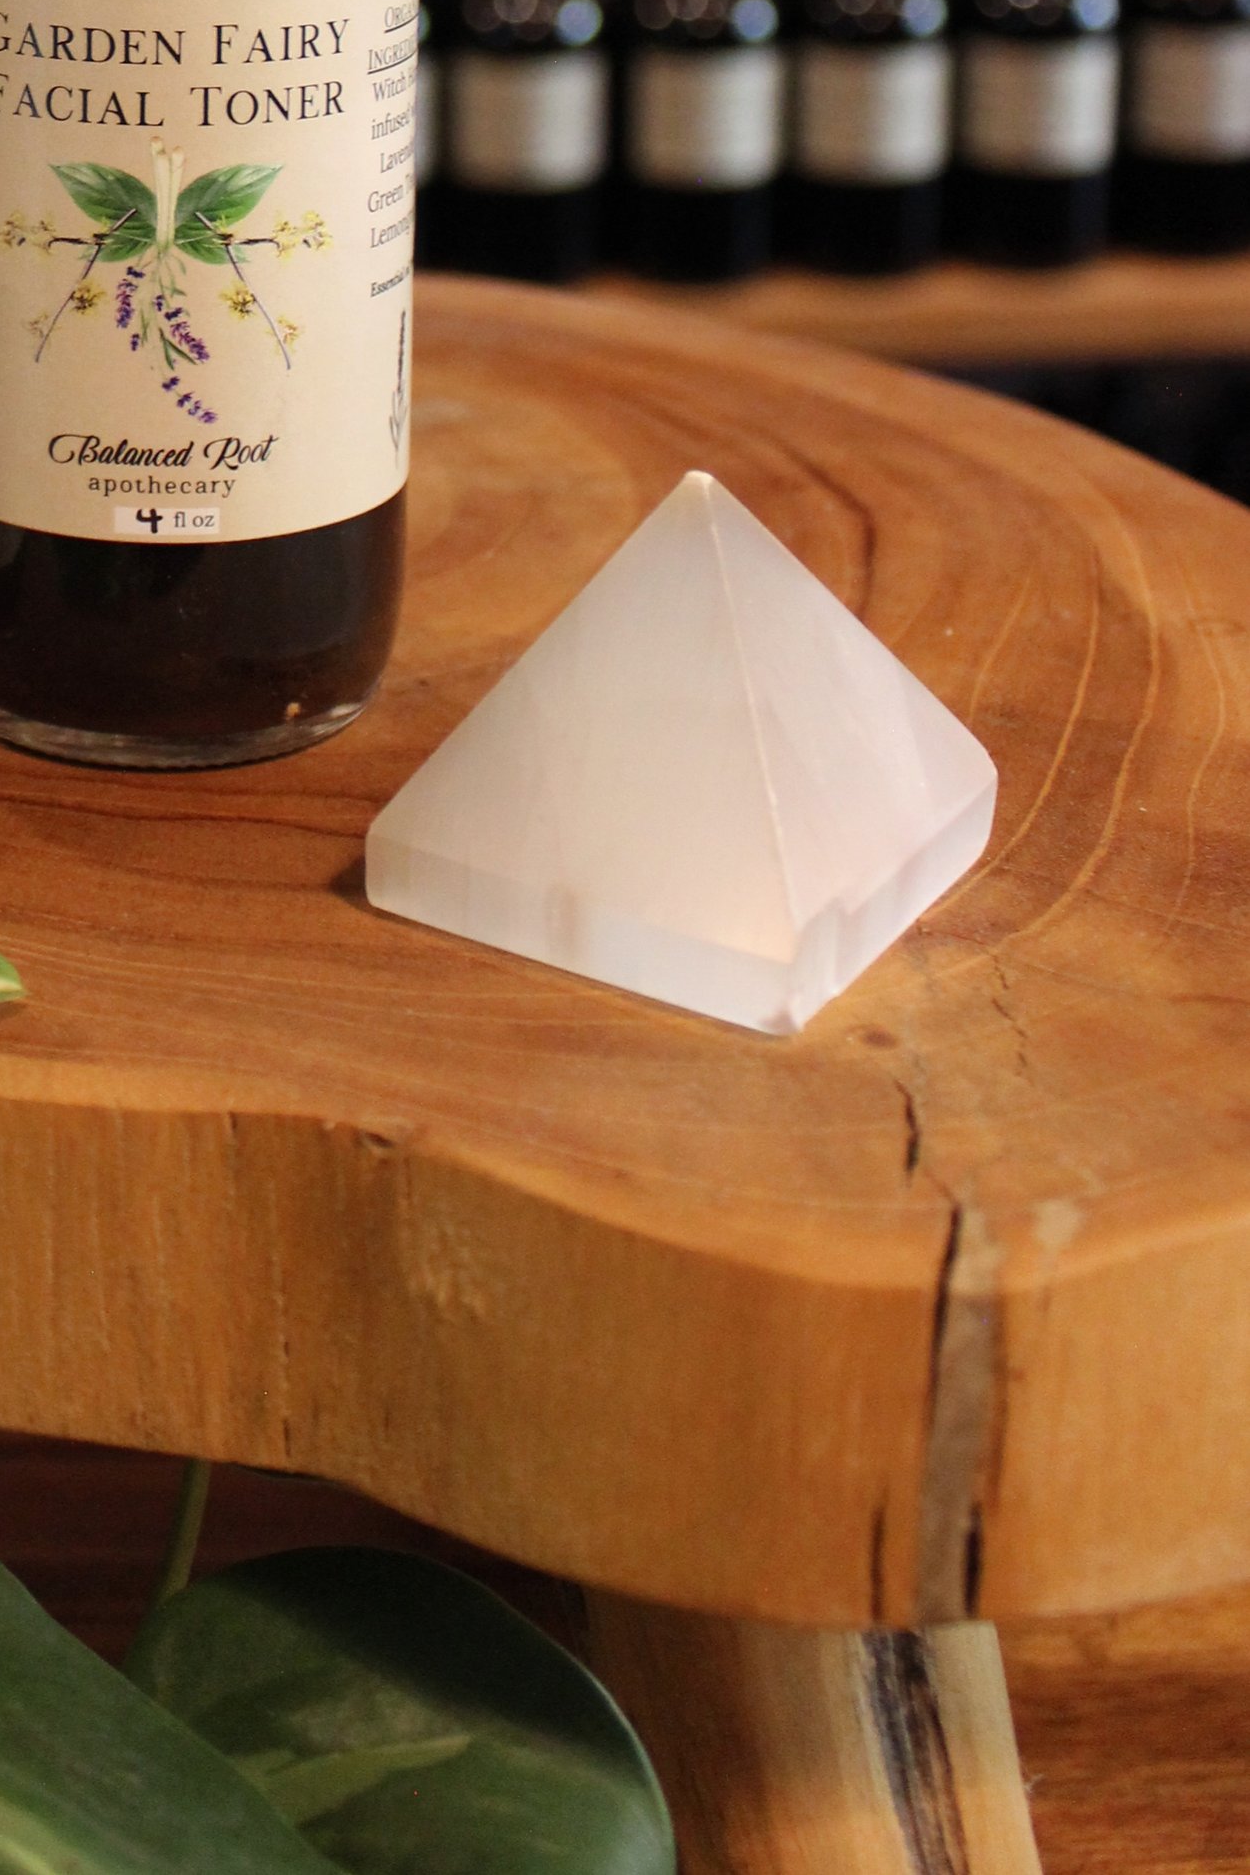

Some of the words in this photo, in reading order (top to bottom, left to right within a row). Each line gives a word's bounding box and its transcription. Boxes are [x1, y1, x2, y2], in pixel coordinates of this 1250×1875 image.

[212, 18, 351, 66] FAIRY
[371, 71, 406, 102] Witch
[190, 81, 346, 127] TONER
[367, 183, 404, 214] Green
[48, 434, 195, 467] Balanced
[203, 435, 280, 471] Root
[88, 475, 236, 498] apothecary
[136, 508, 163, 534] 4
[174, 511, 186, 528] fl
[192, 514, 215, 528] oz
